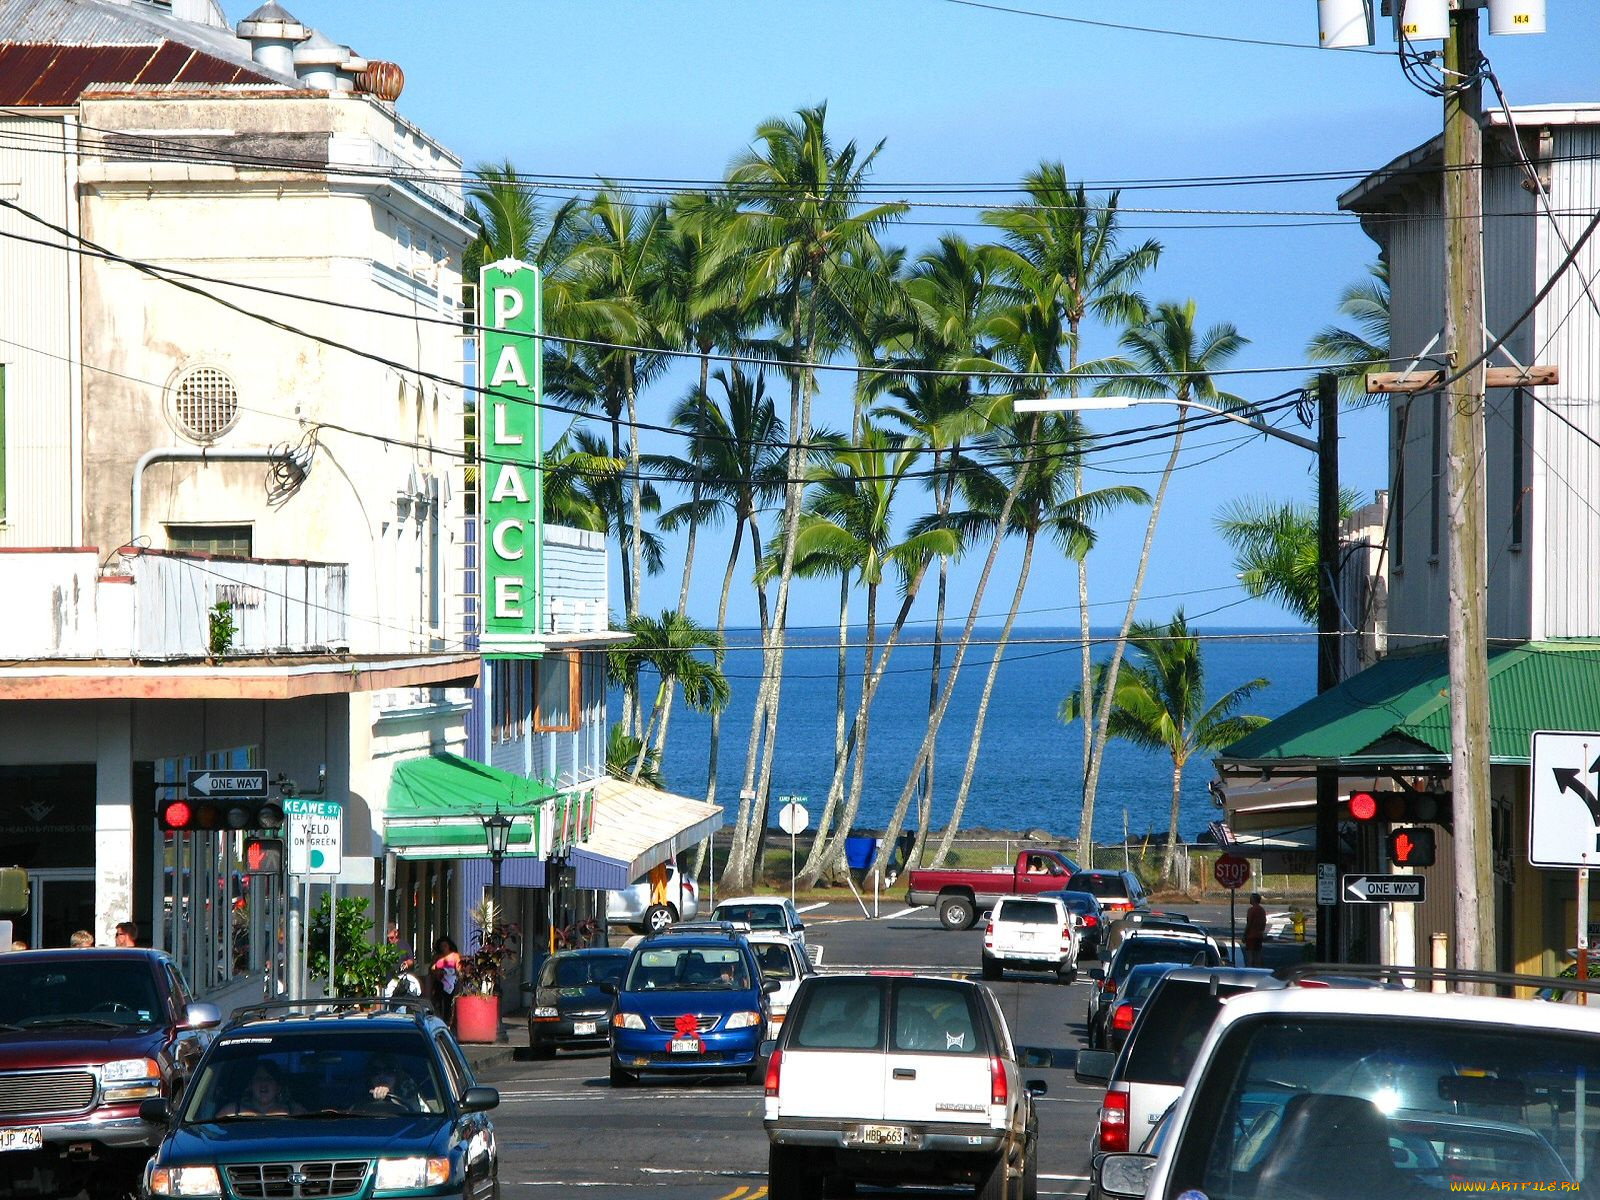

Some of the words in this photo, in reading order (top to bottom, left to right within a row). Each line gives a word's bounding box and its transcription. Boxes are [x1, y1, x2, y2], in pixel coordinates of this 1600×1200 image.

[1513, 15, 1529, 24] 14.4
[488, 286, 530, 619] PALACE
[211, 778, 233, 789] ONE
[236, 778, 259, 789] WAY
[284, 800, 325, 815] KEAWE
[301, 824, 329, 835] YELD
[294, 837, 305, 846] ON
[310, 838, 337, 846] GREEN
[1216, 863, 1248, 879] STOP
[1367, 883, 1390, 894] ONE
[1393, 883, 1416, 894] WAY
[22, 1132, 40, 1145] 464
[865, 1129, 882, 1141] HBB
[886, 1130, 903, 1142] 663
